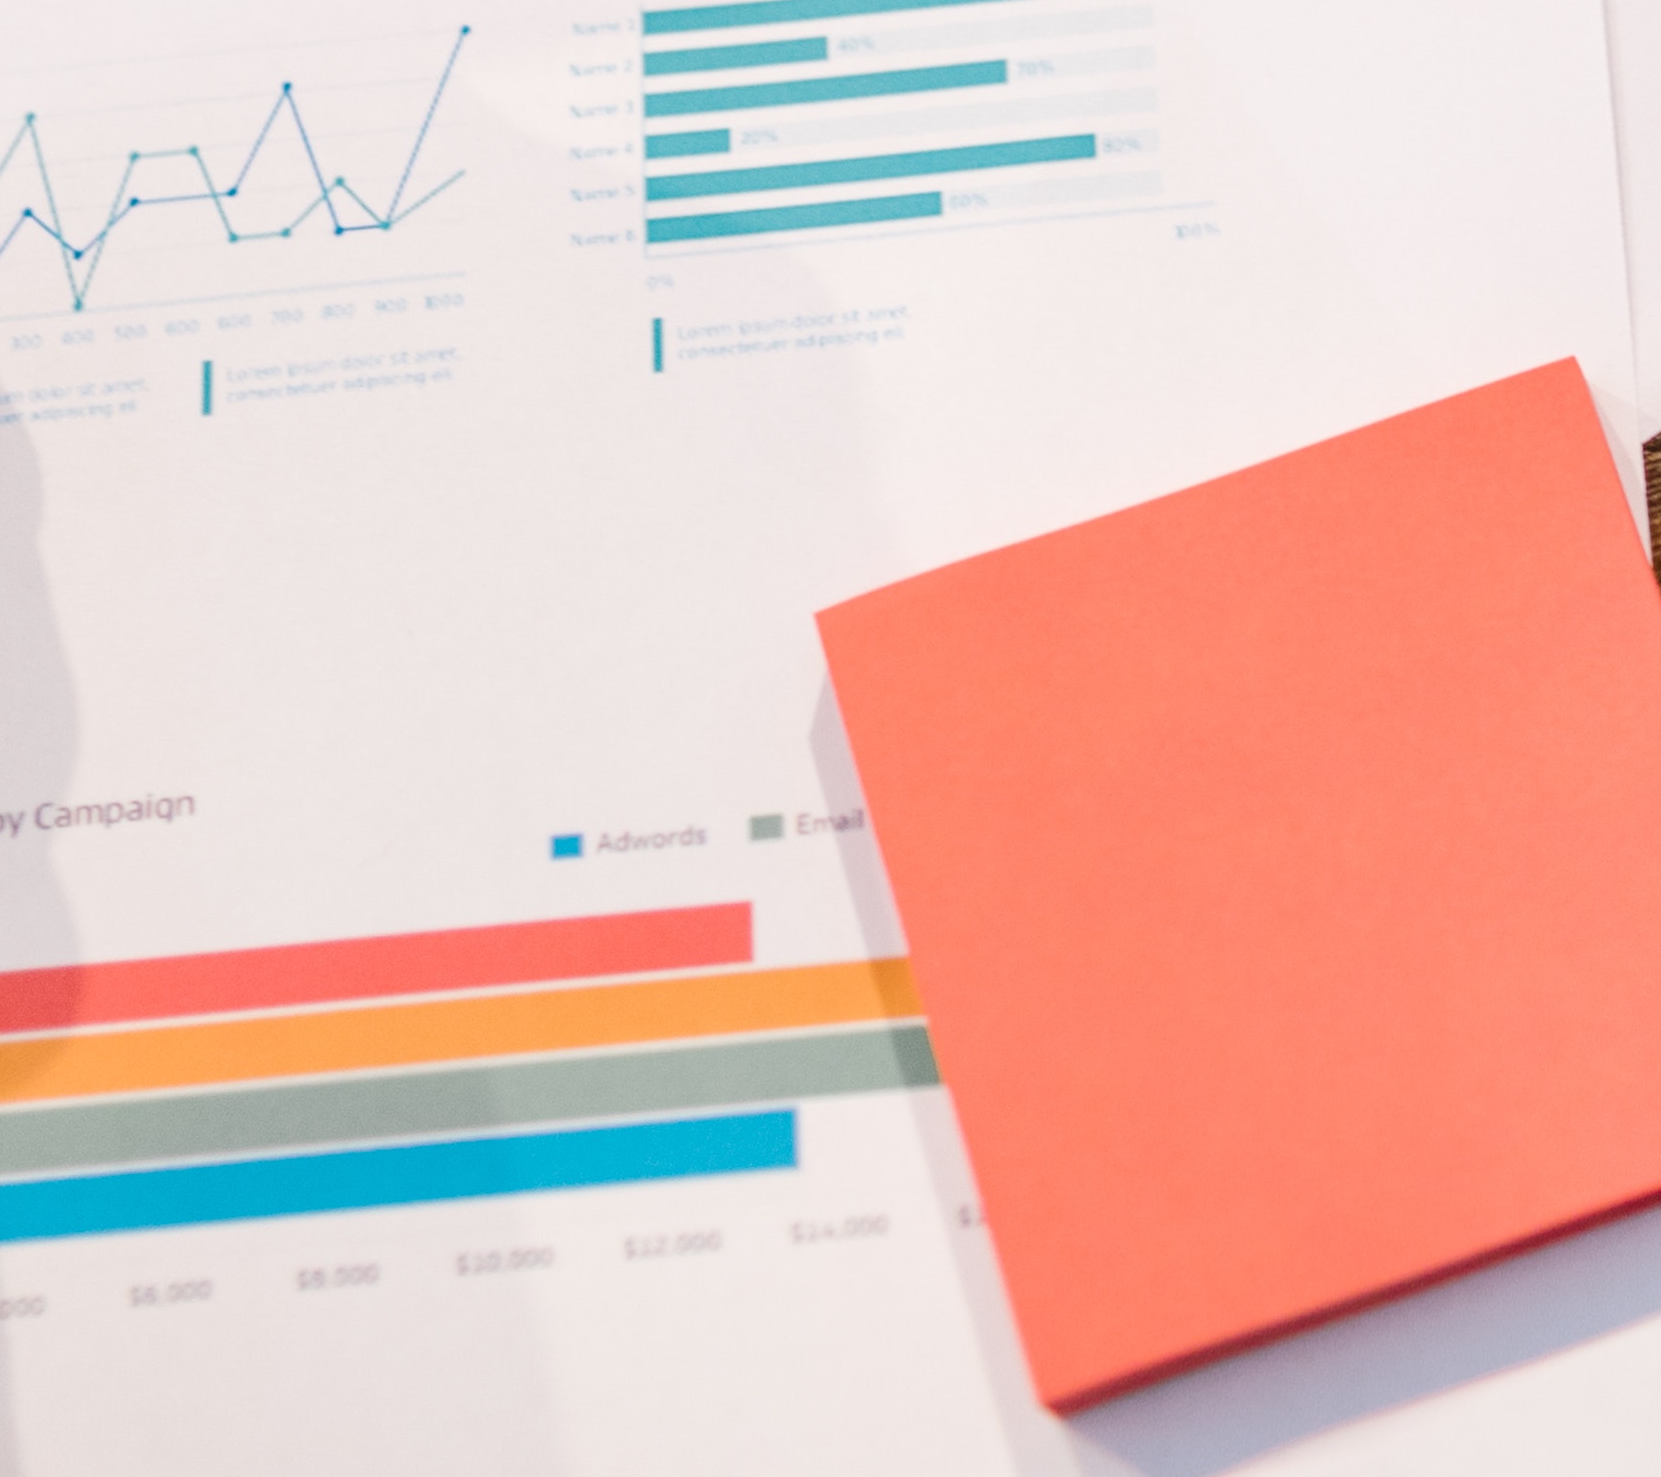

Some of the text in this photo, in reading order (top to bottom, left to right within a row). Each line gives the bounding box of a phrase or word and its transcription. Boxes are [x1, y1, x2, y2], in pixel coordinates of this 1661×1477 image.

[33, 792, 196, 832] Campaign
[596, 809, 865, 853] Adwords Email
